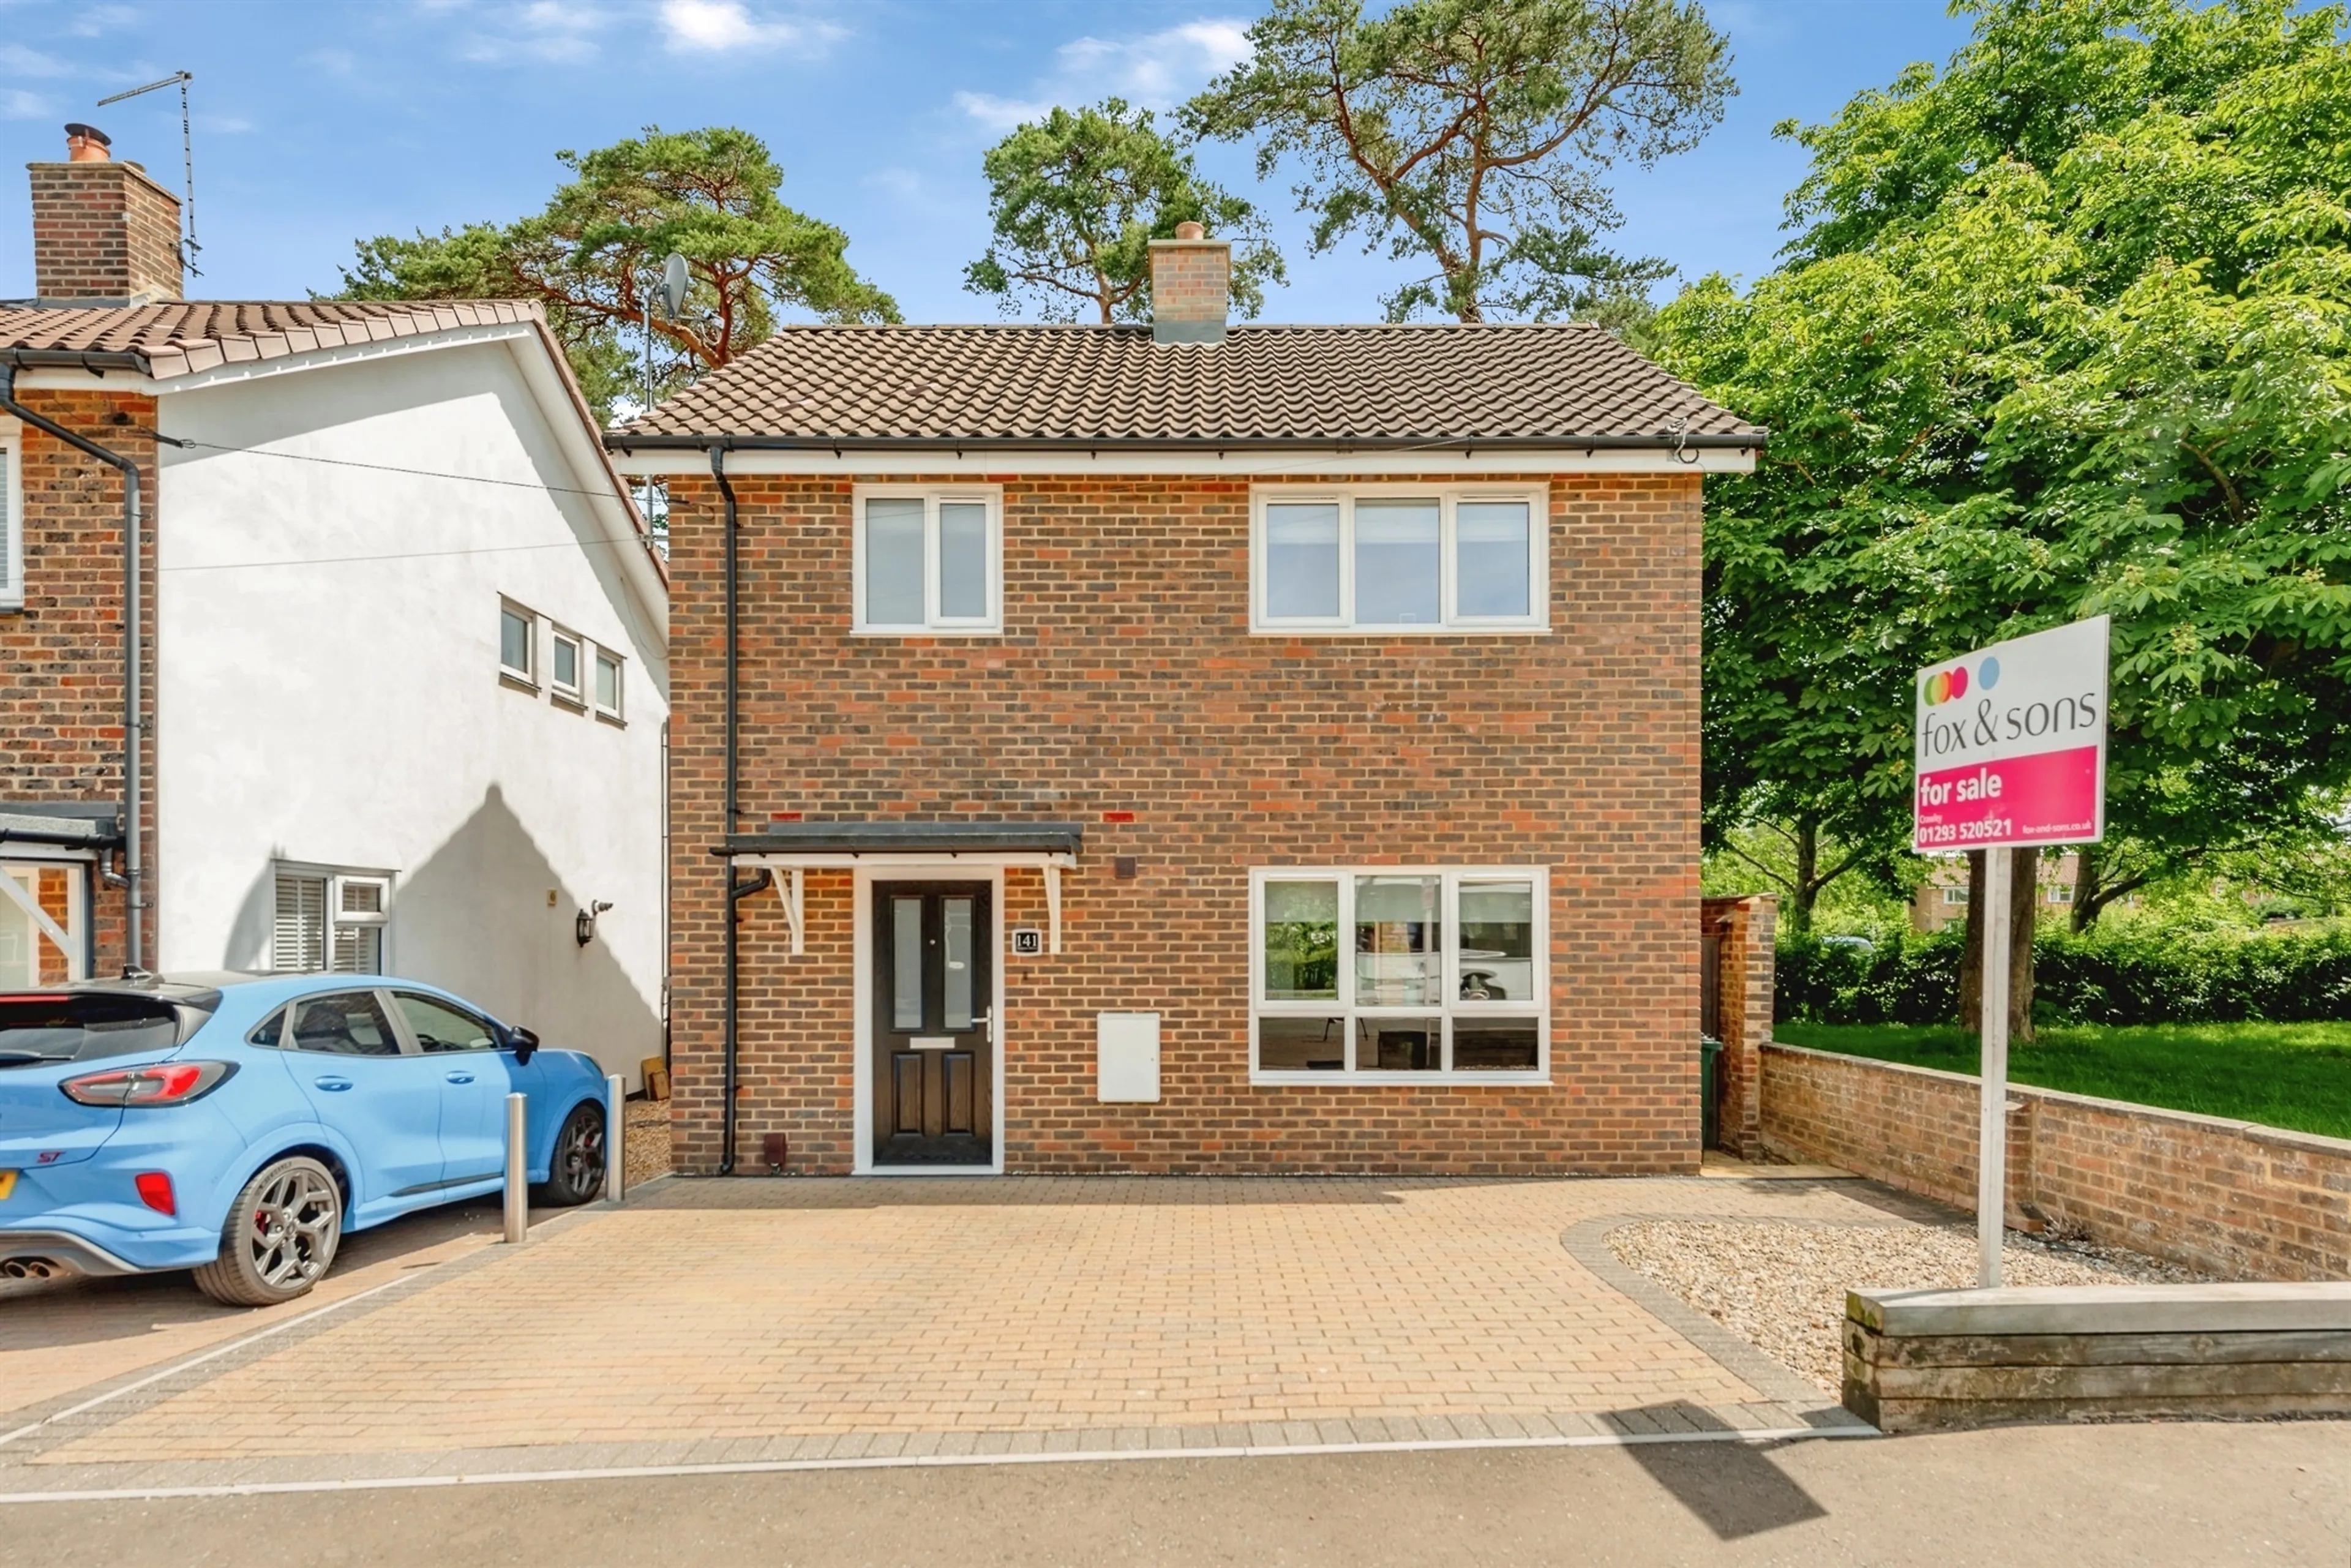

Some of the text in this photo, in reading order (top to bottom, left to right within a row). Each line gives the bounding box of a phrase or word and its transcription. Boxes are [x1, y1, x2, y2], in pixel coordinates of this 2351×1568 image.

[1922, 692, 2096, 757] fox & sons
[1919, 767, 2003, 807] for sale
[1919, 818, 2012, 843] 01293 520521
[2022, 819, 2092, 834] fox-and-sons.co.uk
[1016, 934, 1037, 947] 141
[37, 1151, 66, 1164] ST
